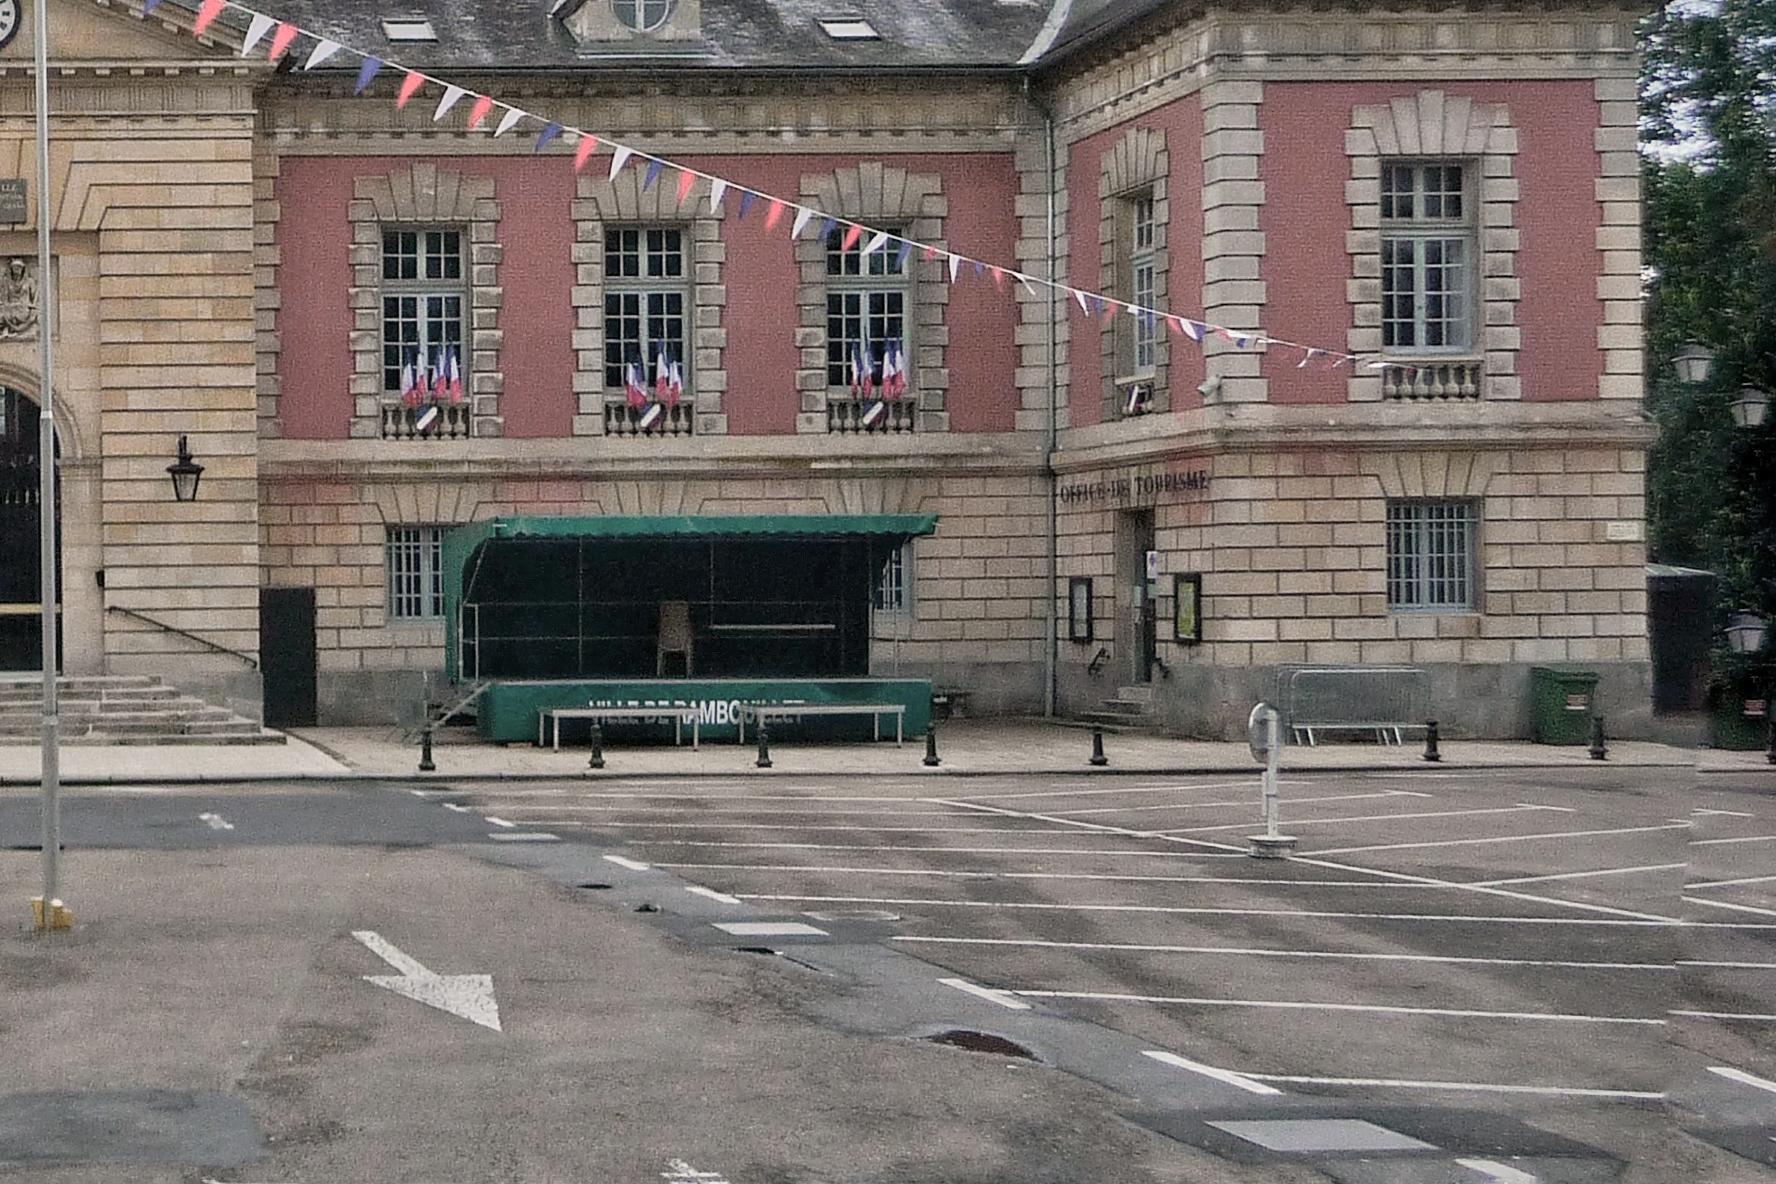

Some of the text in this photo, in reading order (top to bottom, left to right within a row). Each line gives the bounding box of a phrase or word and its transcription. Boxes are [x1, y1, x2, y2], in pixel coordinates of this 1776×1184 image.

[1060, 481, 1105, 504] OFFICE
[1134, 469, 1209, 496] TOURISME
[589, 700, 639, 725] VILLE
[644, 700, 670, 725] DE
